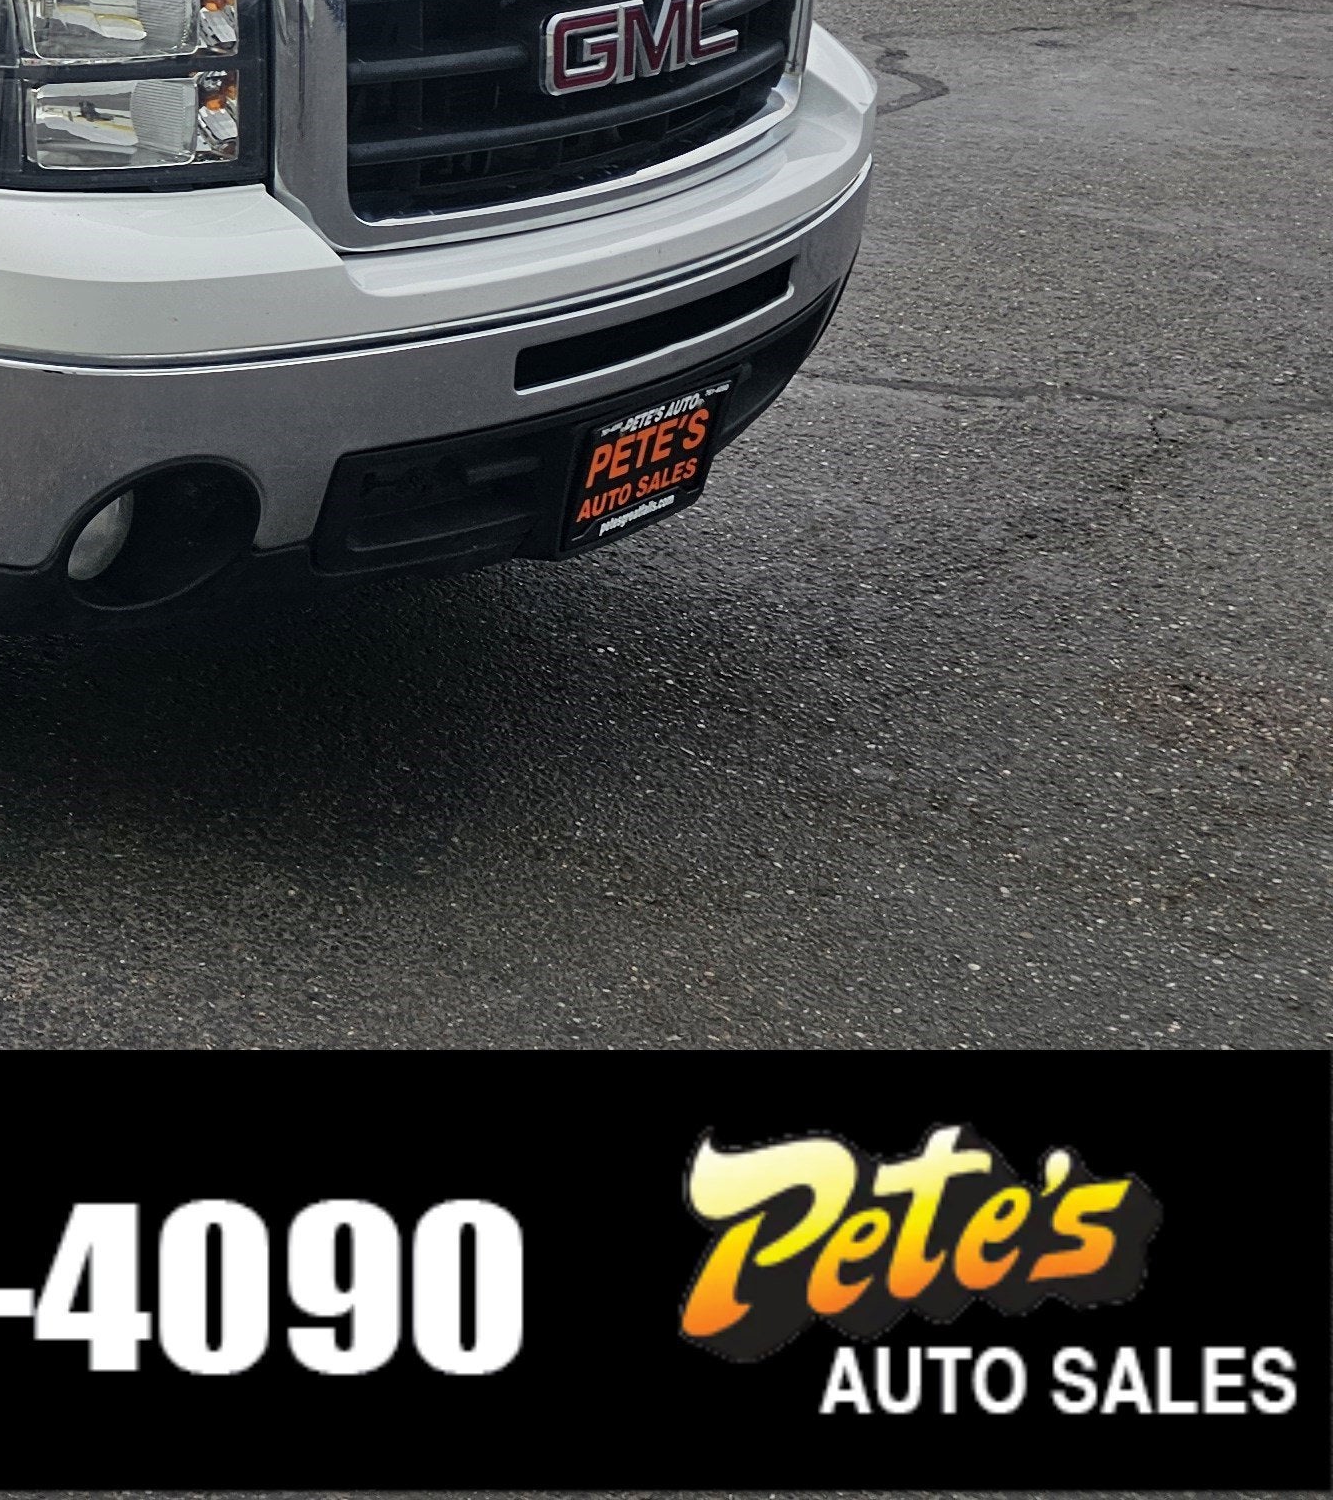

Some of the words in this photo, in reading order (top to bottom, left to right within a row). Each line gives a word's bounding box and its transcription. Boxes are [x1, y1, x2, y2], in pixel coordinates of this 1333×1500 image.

[664, 392, 701, 419] AUTO
[585, 408, 710, 489] PETE'S
[576, 482, 632, 523] AUTO
[635, 457, 698, 498] SALES
